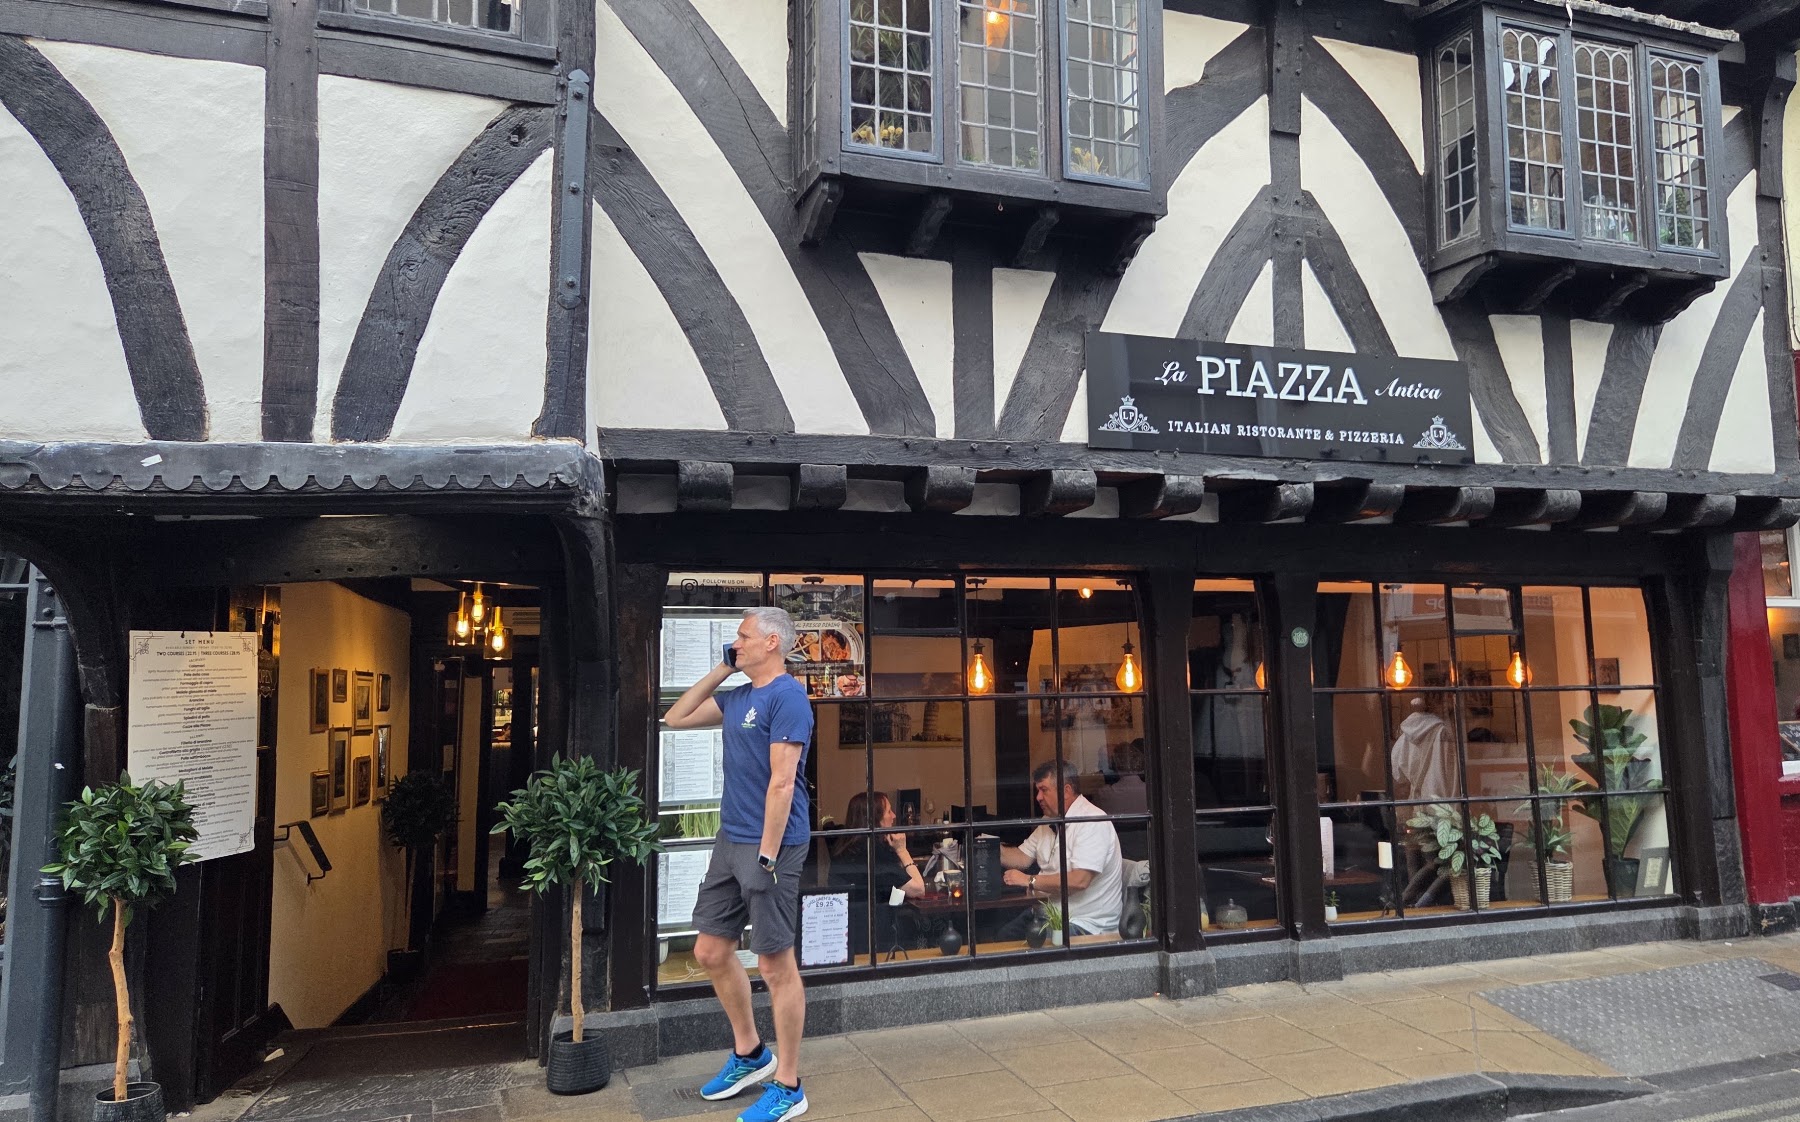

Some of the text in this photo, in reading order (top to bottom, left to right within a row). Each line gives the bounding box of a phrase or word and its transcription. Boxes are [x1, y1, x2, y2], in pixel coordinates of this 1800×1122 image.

[1155, 355, 1442, 405] La PIAZZA Antica
[1123, 411, 1135, 420] LP
[1168, 420, 1405, 445] ITALIAN RISTORANTE & PIZZERIA
[1433, 430, 1444, 438] LP
